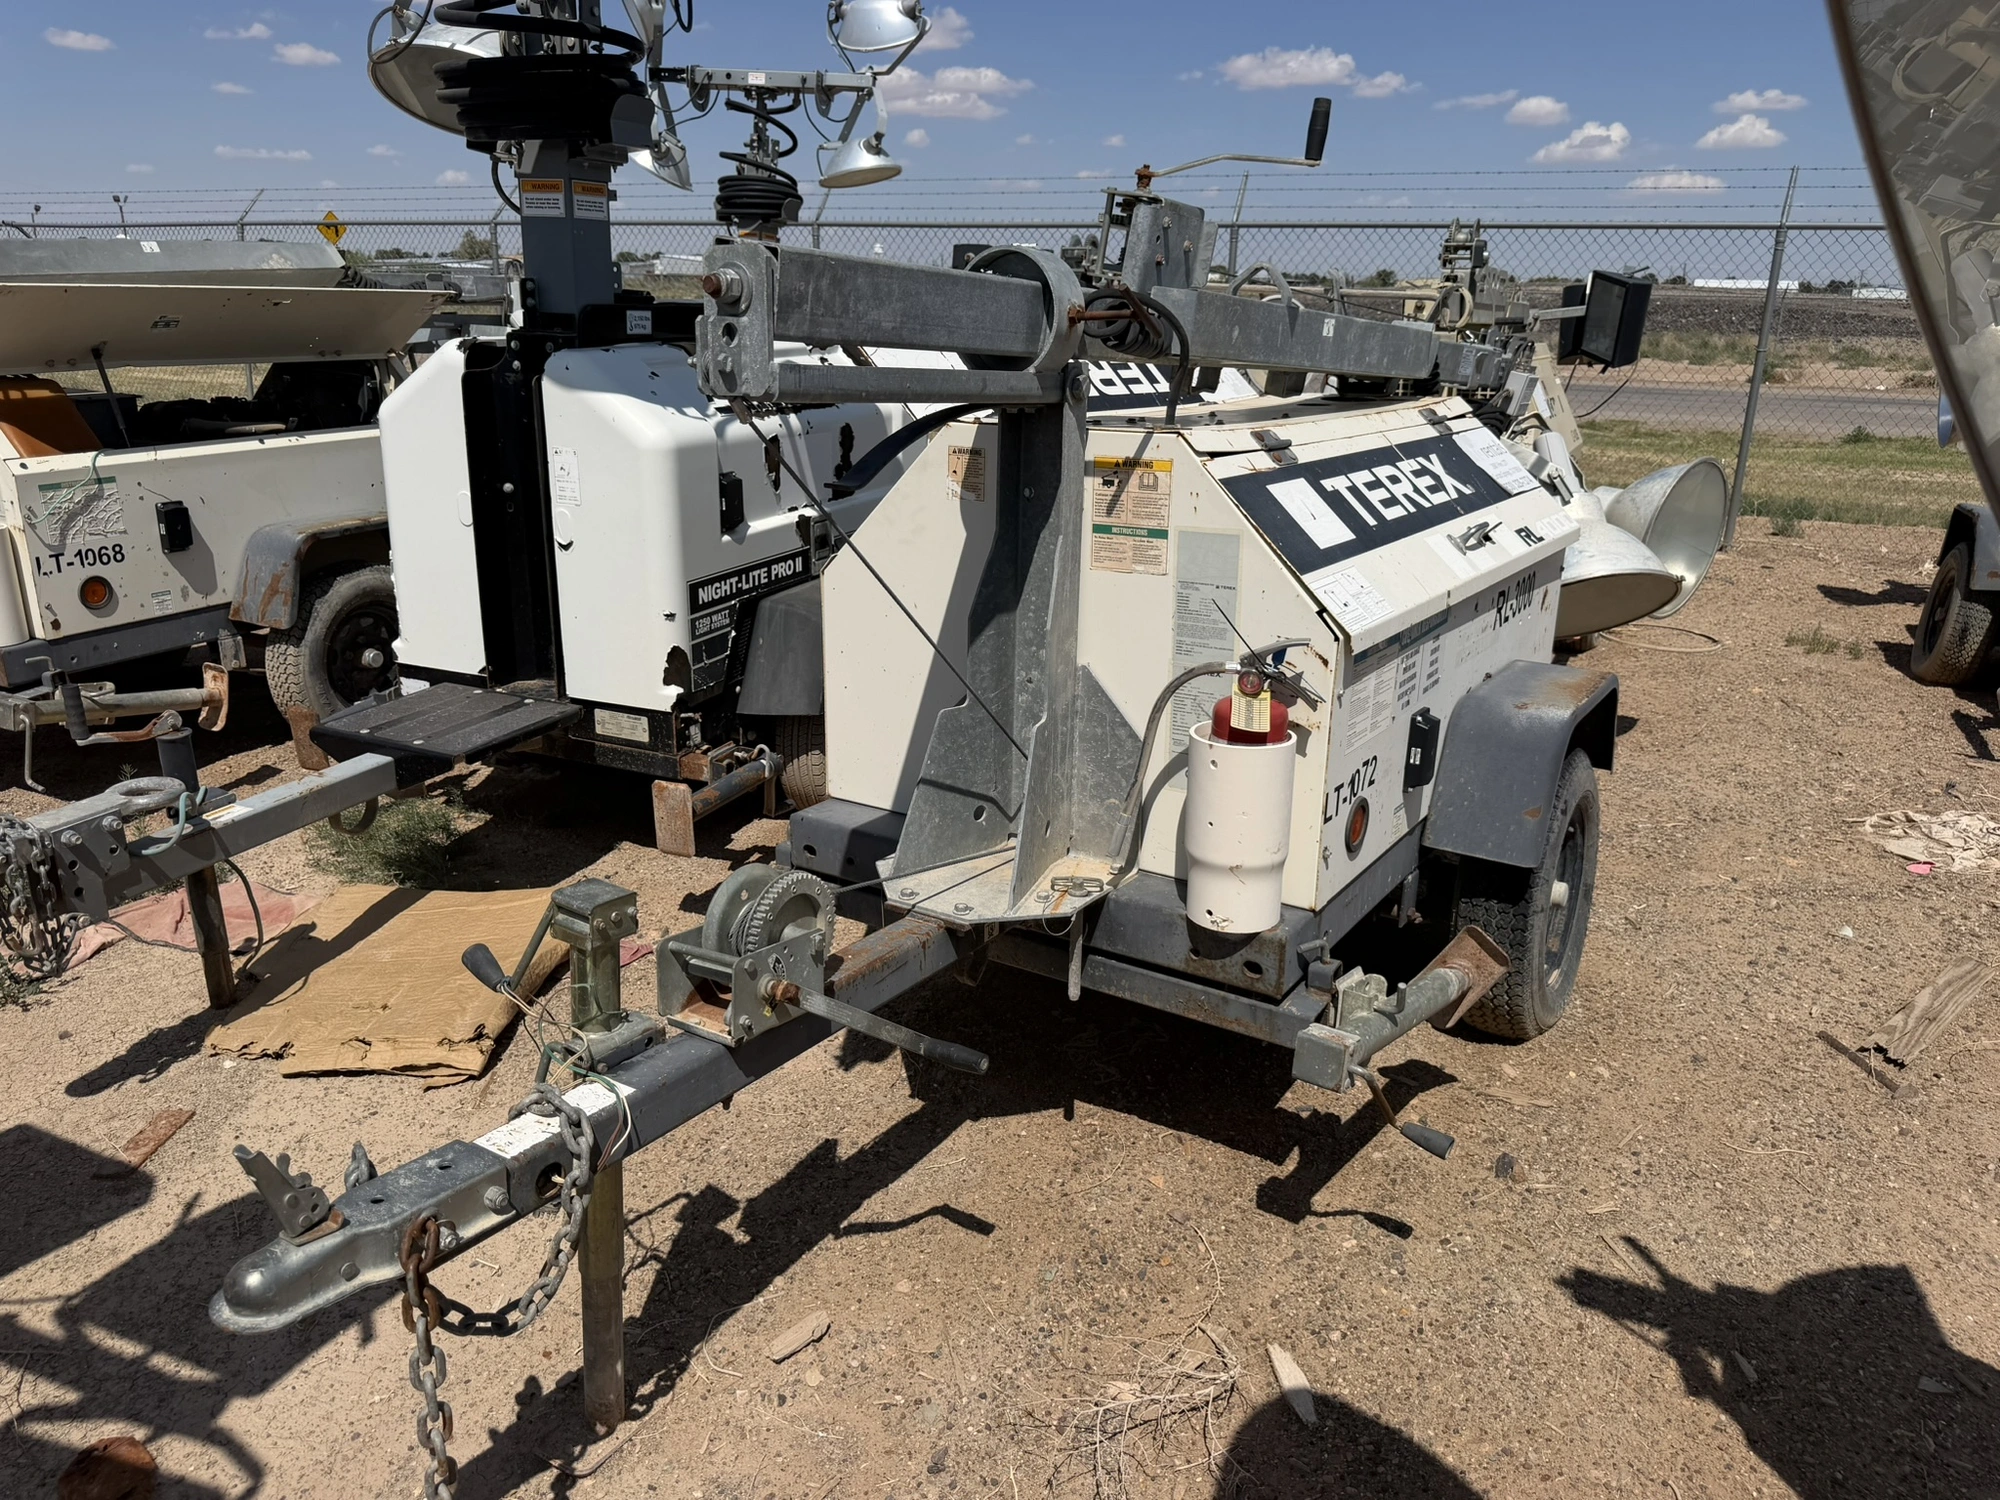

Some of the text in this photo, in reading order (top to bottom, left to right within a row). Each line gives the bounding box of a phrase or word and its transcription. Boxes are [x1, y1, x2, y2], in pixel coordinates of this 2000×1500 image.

[532, 183, 560, 191] WARNING
[1121, 460, 1154, 470] WARNING
[1320, 453, 1472, 527] TEREX
[1111, 526, 1148, 536] INSTRUCTIONS
[1514, 525, 1545, 547] RL
[35, 543, 125, 577] LT-1068
[698, 556, 802, 604] NIGHT-LITE PRO II
[1493, 570, 1535, 631] RL-3000
[695, 610, 730, 629] 1250 WATT
[695, 618, 730, 635] LIGHT SYSTEM
[1323, 755, 1378, 825] LT-1072
